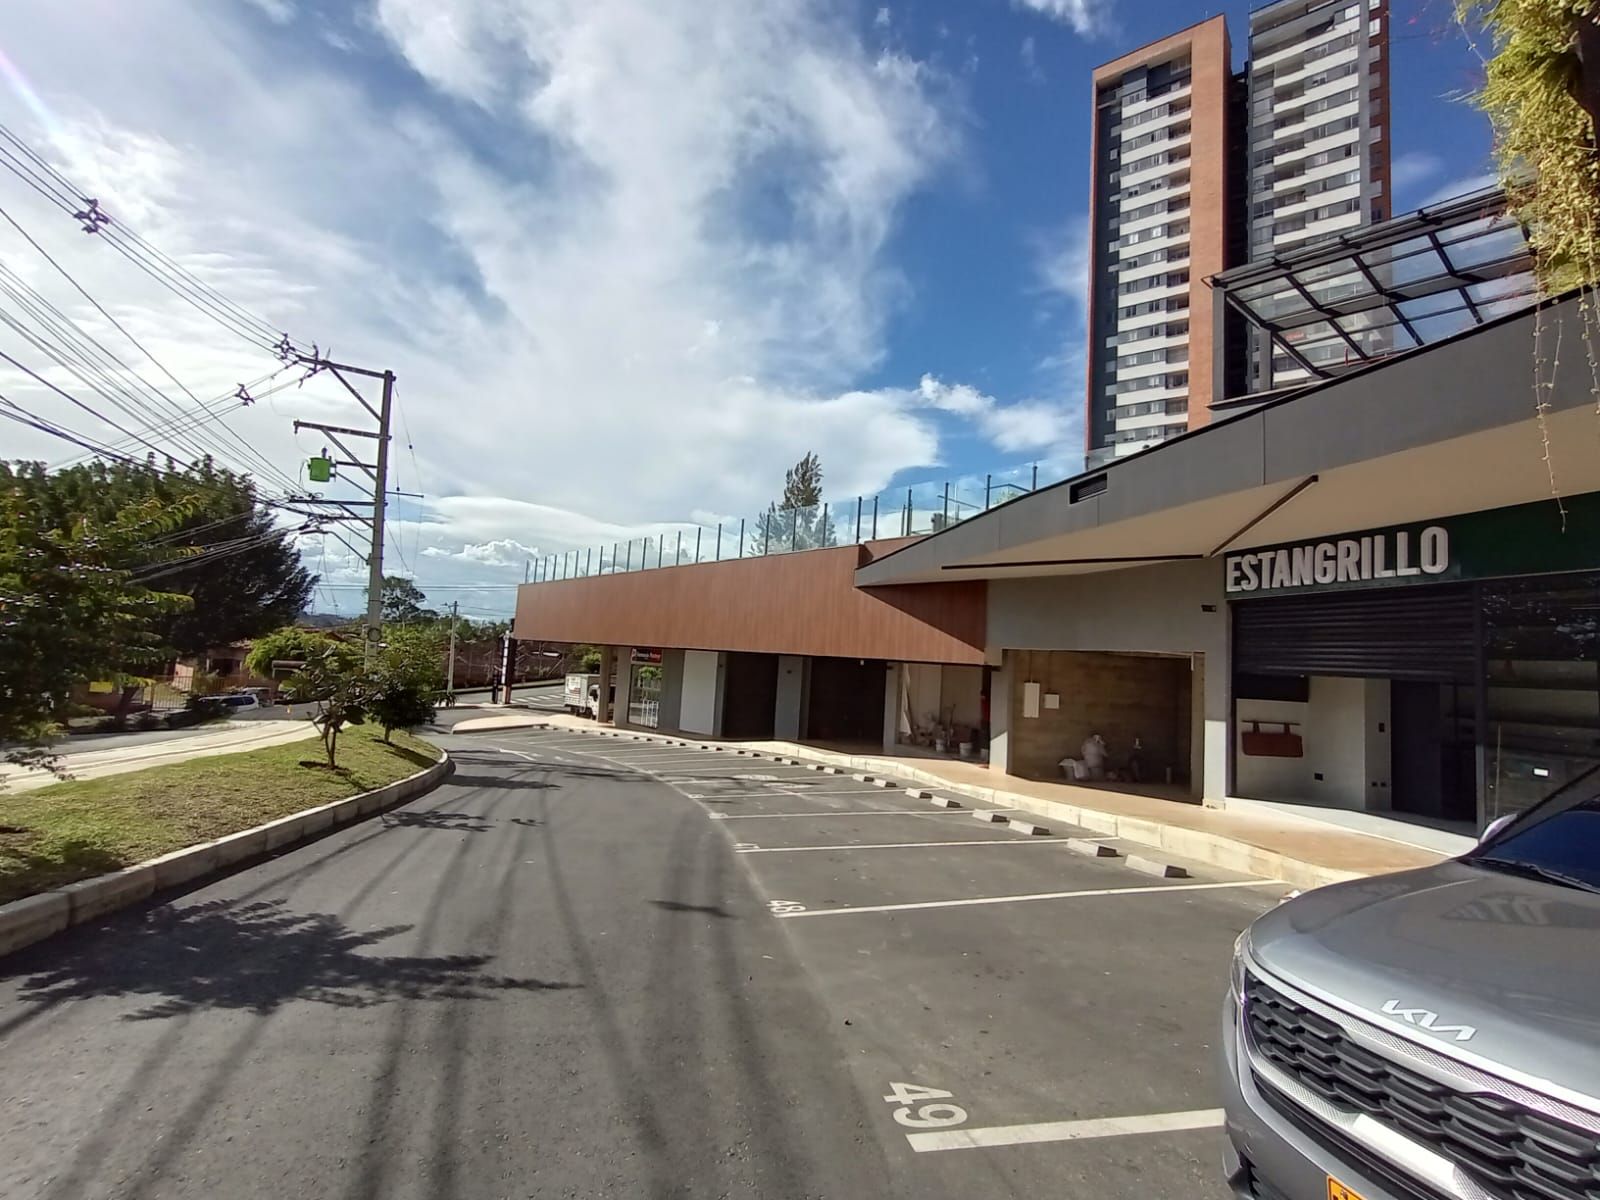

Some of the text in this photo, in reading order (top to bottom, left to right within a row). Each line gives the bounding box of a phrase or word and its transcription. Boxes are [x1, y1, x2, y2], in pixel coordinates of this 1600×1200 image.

[1226, 526, 1449, 592] ESTANGRILLO
[766, 900, 807, 913] 48
[883, 1081, 968, 1128] 49
